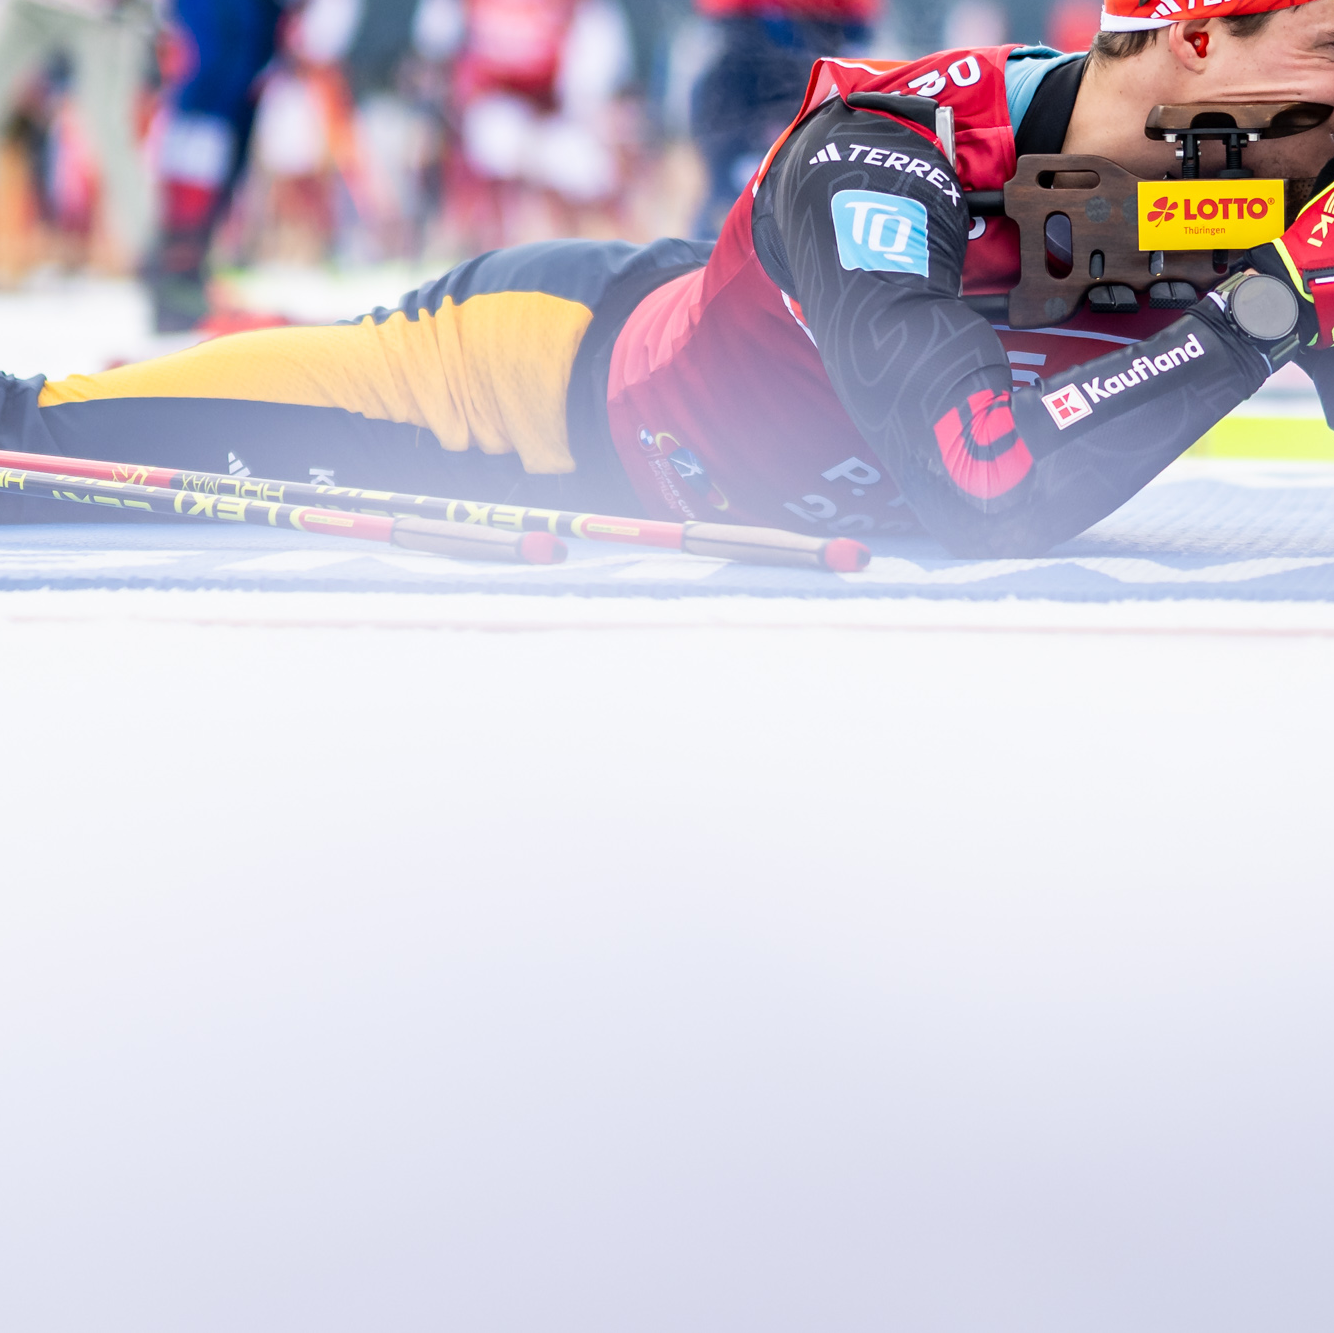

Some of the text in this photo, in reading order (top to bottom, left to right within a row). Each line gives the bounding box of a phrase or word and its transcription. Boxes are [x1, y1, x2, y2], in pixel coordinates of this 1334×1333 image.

[848, 144, 961, 207] TERREX
[845, 201, 914, 263] TQ
[1183, 226, 1226, 236] Thüringen
[1082, 333, 1205, 404] Kaufland
[174, 490, 282, 527] LEKI
[446, 500, 560, 533] LEKI
